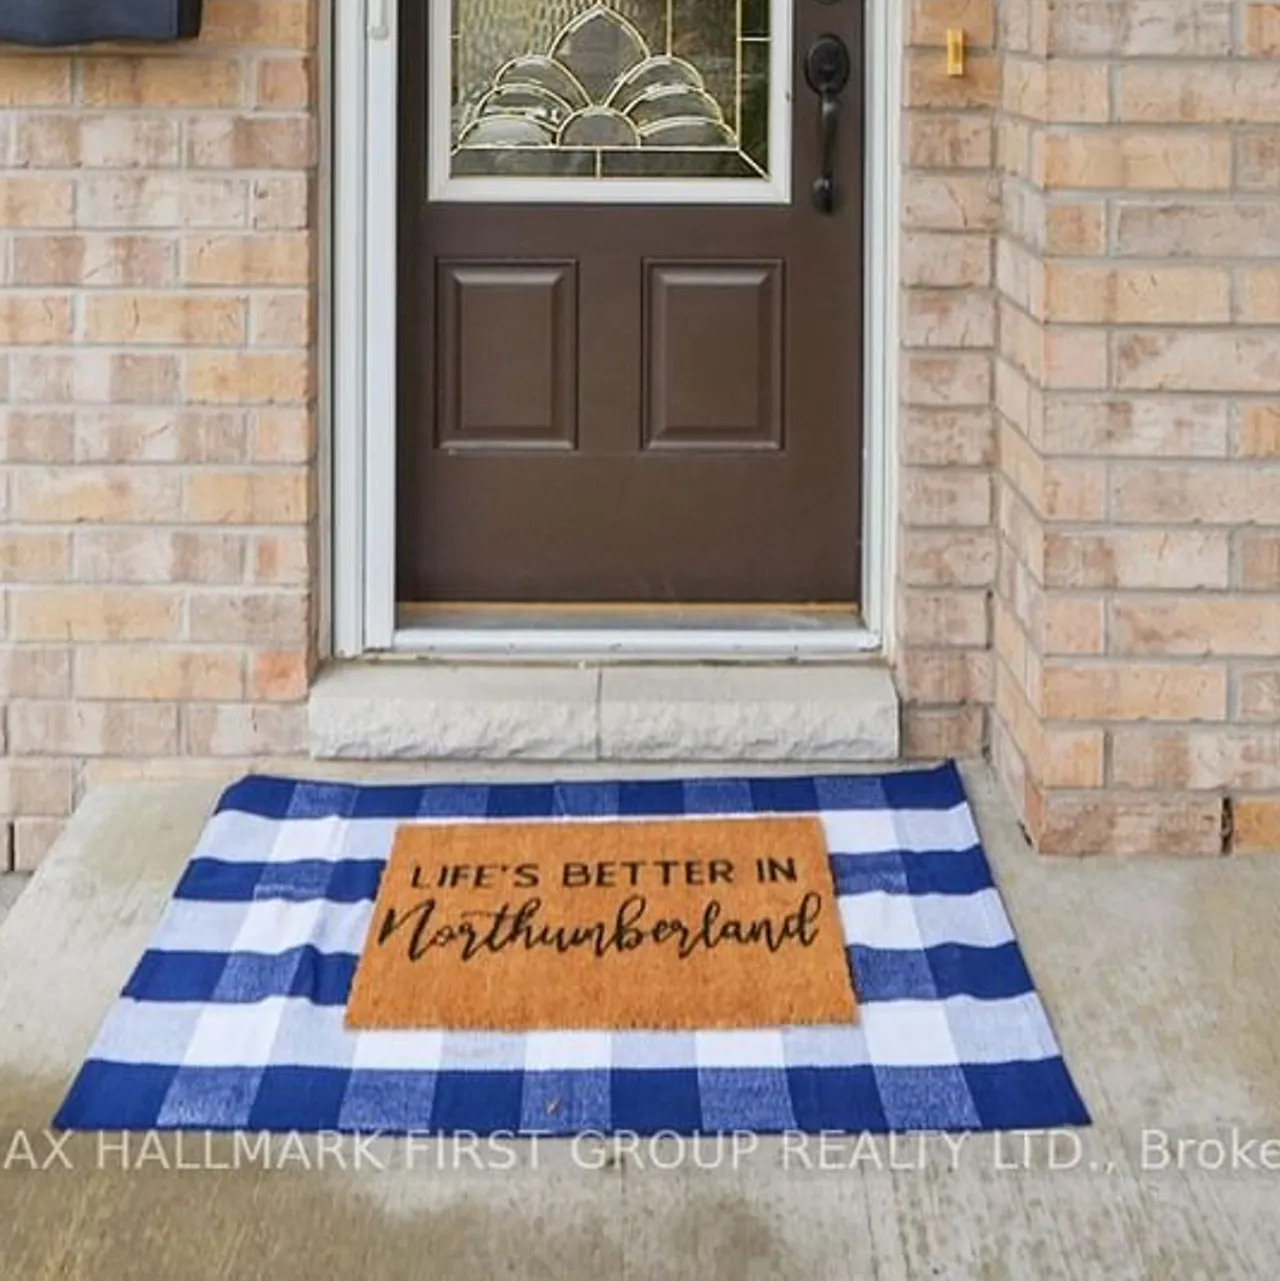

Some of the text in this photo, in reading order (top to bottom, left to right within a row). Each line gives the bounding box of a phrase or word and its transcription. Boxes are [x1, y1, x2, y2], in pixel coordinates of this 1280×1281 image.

[411, 857, 798, 889] LIFE'S BETTER IN
[377, 891, 822, 962] Northumberland
